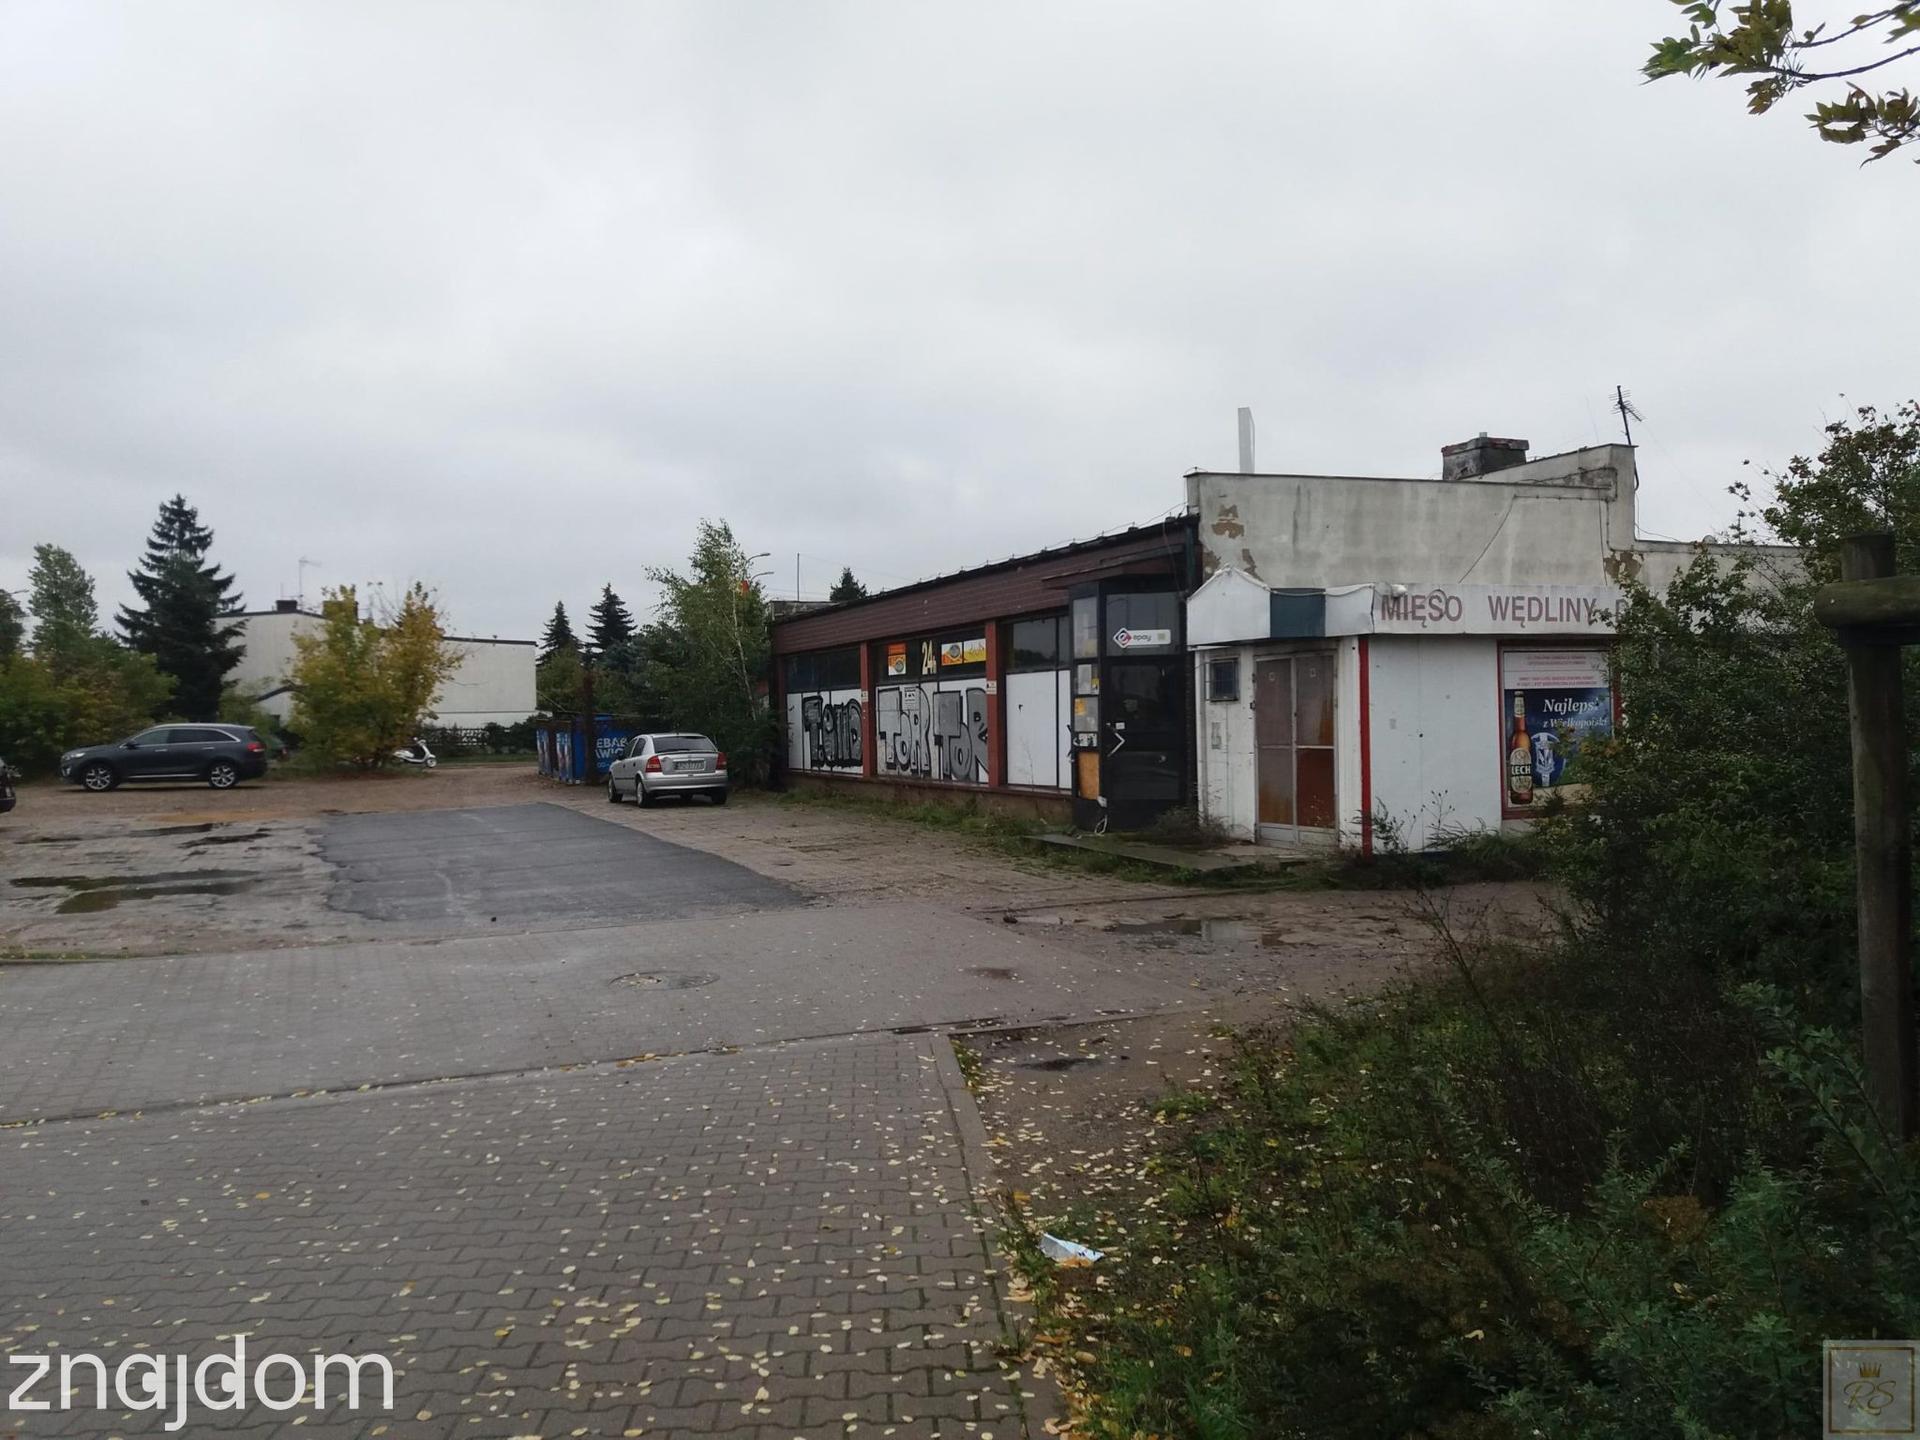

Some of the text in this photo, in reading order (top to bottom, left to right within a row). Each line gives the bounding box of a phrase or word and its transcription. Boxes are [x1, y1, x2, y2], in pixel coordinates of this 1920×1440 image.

[1381, 594, 1463, 628] MIĘSO
[1487, 595, 1597, 628] WĘDLINY
[1511, 765, 1531, 775] LECH
